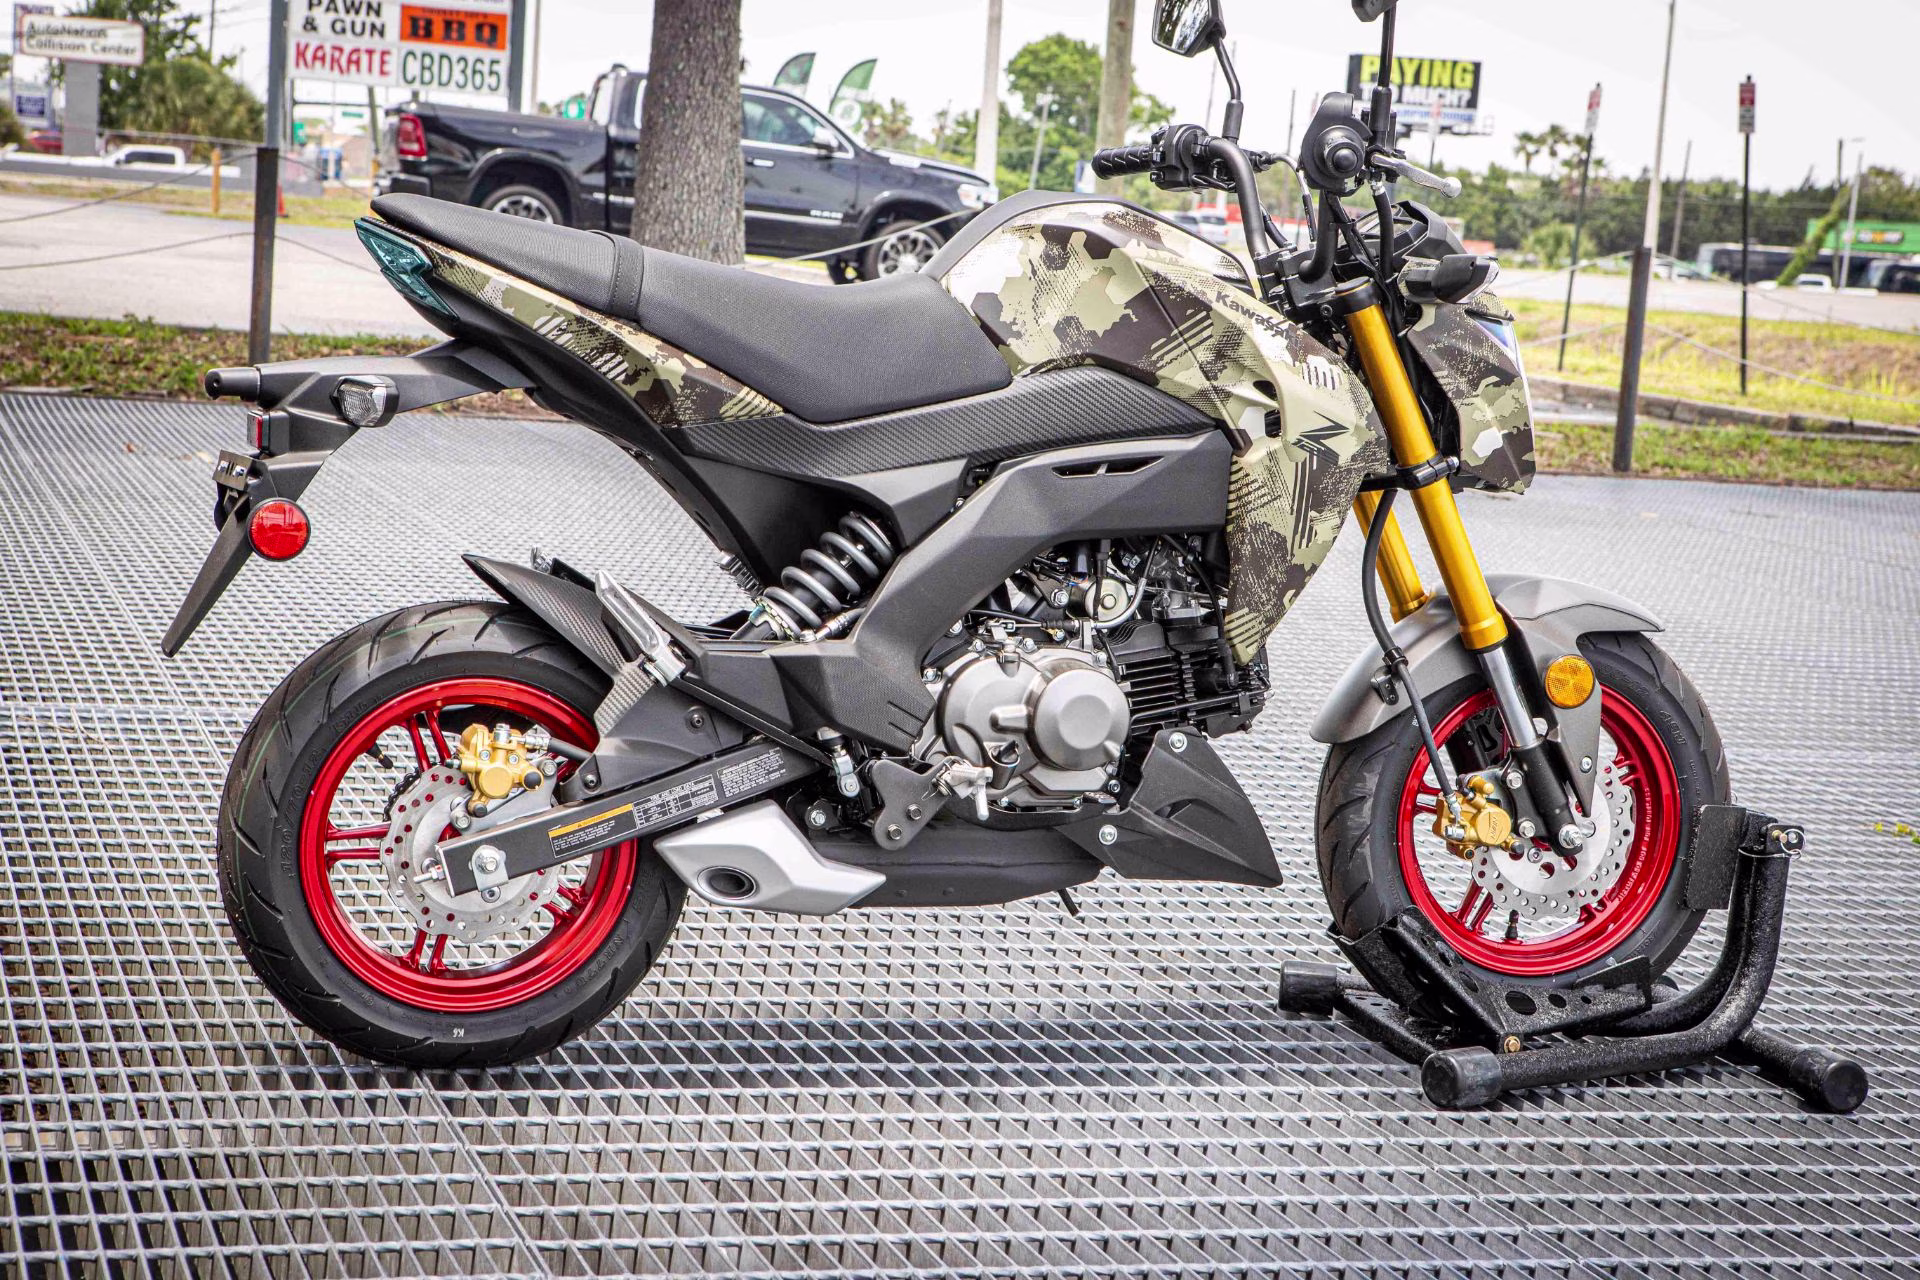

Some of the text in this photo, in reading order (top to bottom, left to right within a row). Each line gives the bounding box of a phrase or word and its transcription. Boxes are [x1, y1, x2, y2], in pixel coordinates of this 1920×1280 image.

[307, 0, 382, 17] PAWN
[26, 21, 108, 39] AutoNation
[303, 17, 386, 38] & GUN
[26, 39, 137, 55] Collision Center
[294, 42, 392, 76] KARATE
[402, 50, 501, 92] CBD365
